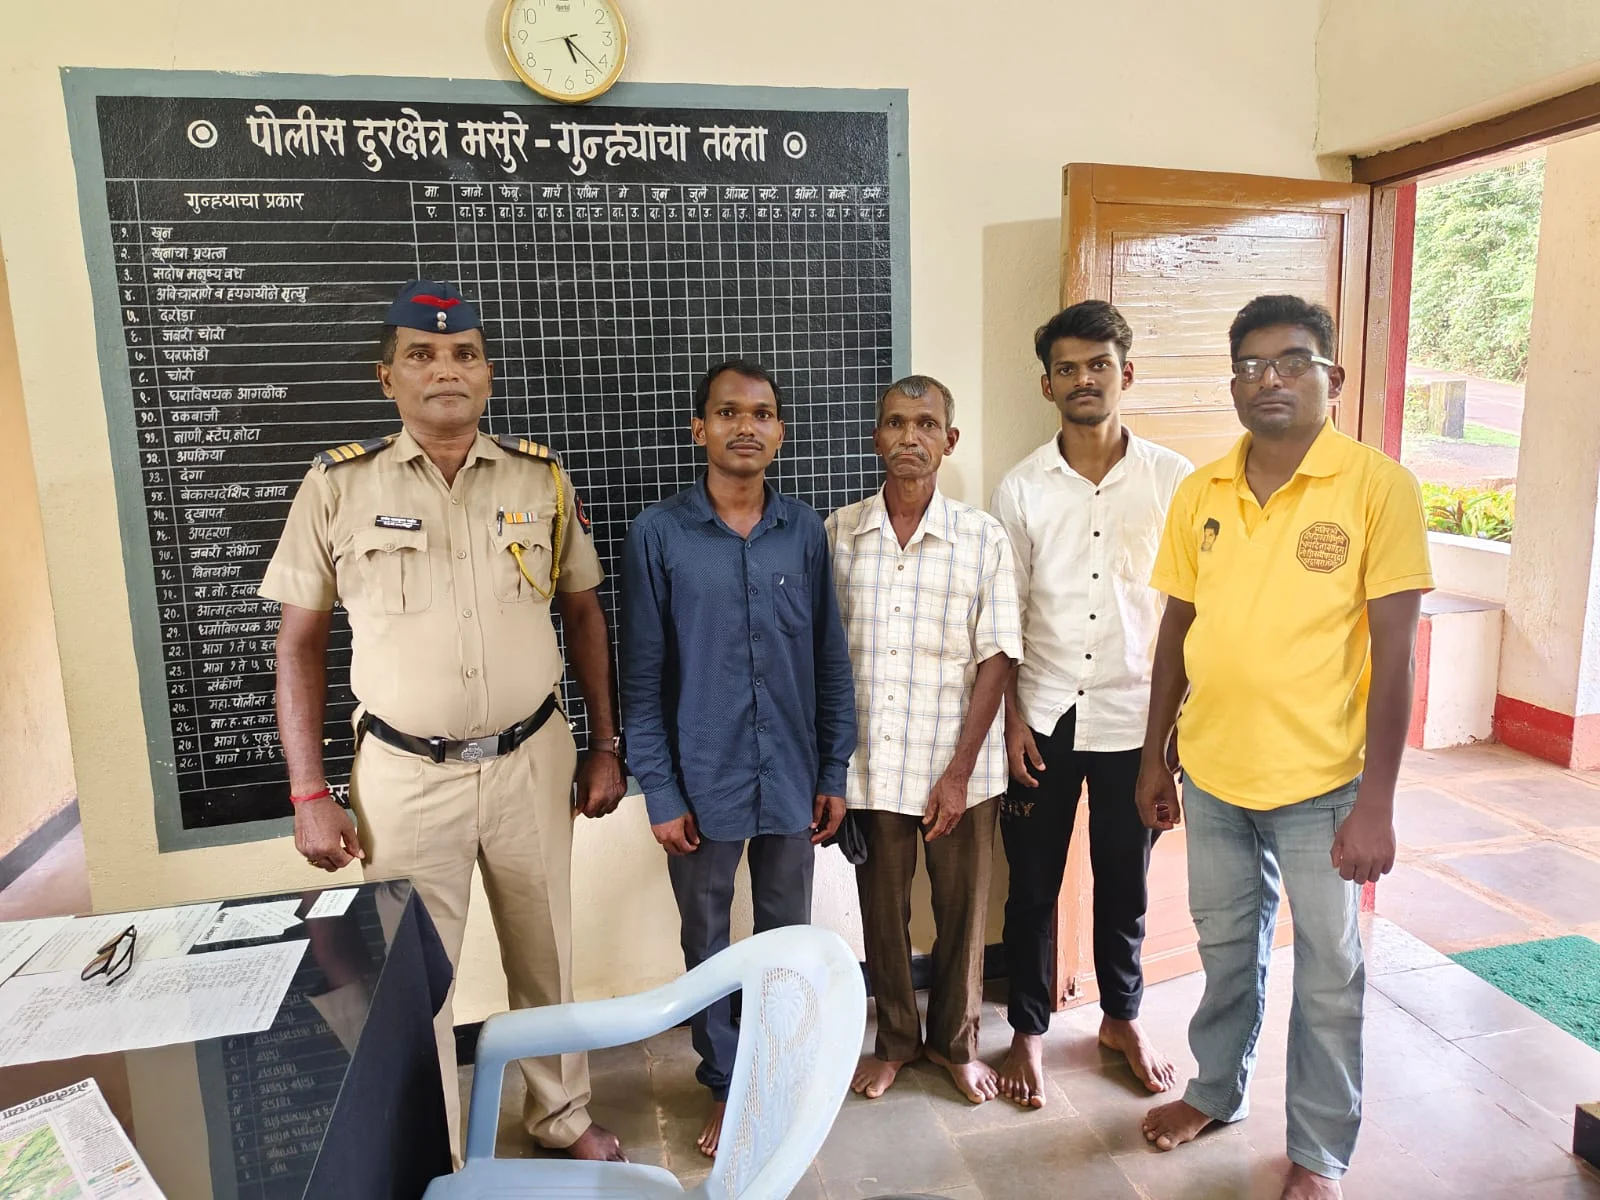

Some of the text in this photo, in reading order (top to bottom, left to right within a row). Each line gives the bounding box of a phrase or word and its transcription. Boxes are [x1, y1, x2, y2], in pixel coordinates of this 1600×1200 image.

[523, 8, 537, 25] 10
[594, 8, 606, 25] 2
[517, 29, 528, 45] 9
[602, 31, 613, 47] 3
[526, 52, 537, 68] 8
[598, 53, 609, 69] 4
[543, 68, 553, 83] 7
[564, 75, 575, 91] 6
[584, 70, 595, 85] 5
[246, 104, 347, 158] पोलीस
[353, 107, 449, 173] दुरक्षेत्र
[458, 111, 530, 174] मसुरे
[698, 124, 769, 163] तक्ता
[263, 192, 305, 211] प्रकार
[617, 184, 630, 199] मे
[651, 188, 671, 204] जून
[151, 226, 173, 242] खून
[121, 246, 228, 264] २. खूनाचा प्रयत्न
[124, 263, 246, 284] ३. सदोष मनुष्य वध
[123, 289, 136, 302] ४.
[214, 287, 225, 300] व
[158, 306, 197, 323] दरोडा
[161, 326, 195, 342] जबरी
[197, 326, 227, 342] चोरी
[162, 346, 210, 364] घरफोडी
[138, 367, 196, 384] ८. चोरी
[237, 384, 289, 402] आगळीक
[141, 407, 220, 424] १०. ठकबाजी
[144, 431, 159, 444] ११.
[146, 448, 225, 464] १२. अपक्रिया
[149, 467, 206, 483] १३. दंगा
[151, 491, 167, 502] १४.
[254, 485, 289, 499] जमाव
[184, 507, 226, 524] दुखापत
[188, 527, 233, 541] अपहरण
[188, 543, 222, 559] जबरी
[225, 543, 262, 557] संभोग
[192, 562, 243, 579] विनयभंग
[230, 582, 261, 598] हरक
[164, 607, 182, 620] २०.
[166, 626, 182, 639] २१.
[168, 645, 185, 658] २२.
[202, 642, 224, 656] भाग
[236, 638, 247, 653] ते
[169, 665, 186, 678] २३.
[203, 661, 225, 674] भाग
[237, 658, 249, 673] ते
[206, 676, 244, 693] संकीर्ण
[214, 735, 238, 748] भाग
[255, 746, 267, 761] ते
